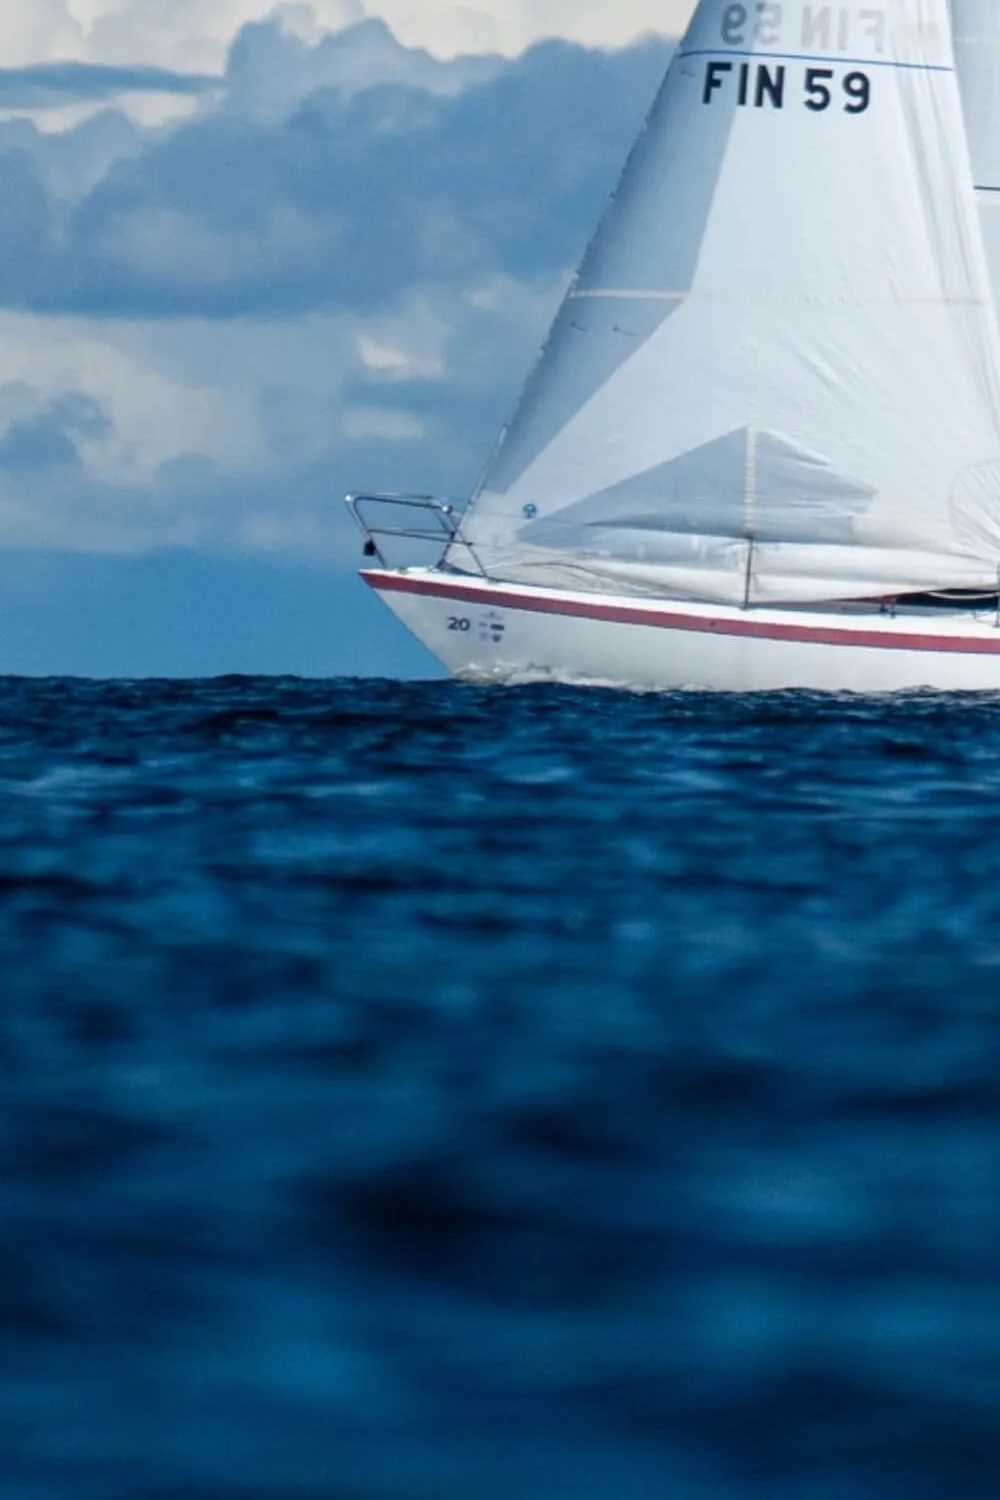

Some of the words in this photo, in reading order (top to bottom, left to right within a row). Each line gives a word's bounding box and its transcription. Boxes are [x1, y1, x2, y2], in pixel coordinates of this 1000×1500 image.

[702, 61, 786, 109] FIN
[803, 68, 870, 114] 59
[448, 616, 470, 631] 20
